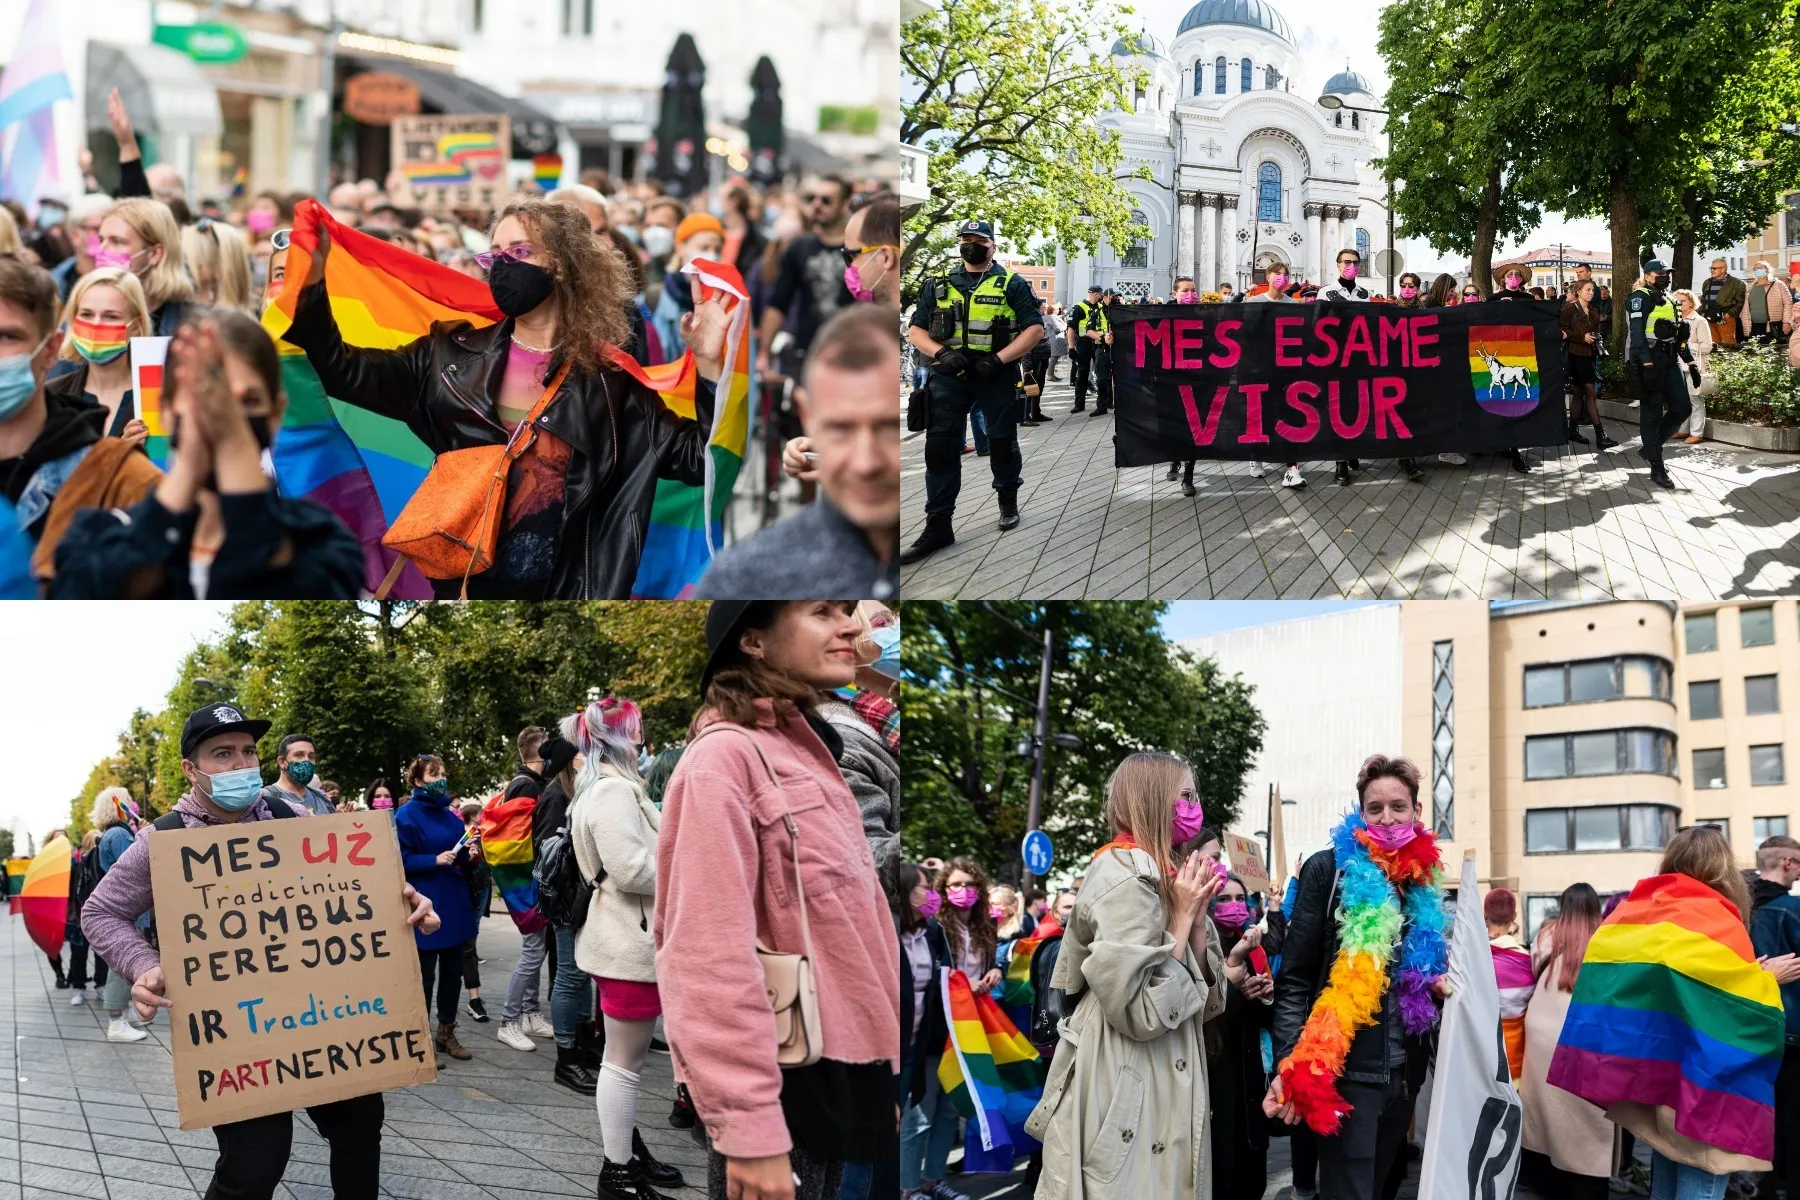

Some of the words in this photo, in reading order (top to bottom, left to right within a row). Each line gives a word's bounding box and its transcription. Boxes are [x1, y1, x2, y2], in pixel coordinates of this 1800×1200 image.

[1134, 318, 1244, 370] MES
[1274, 314, 1441, 368] ESAME
[1178, 377, 1414, 447] VISUR
[180, 834, 281, 883] MES
[302, 822, 376, 867] UŽ
[183, 894, 373, 944] ROMBUS
[192, 873, 362, 910] Tradicinius
[188, 1009, 228, 1047] IR
[198, 1029, 426, 1102] PARTNERYSTĘ
